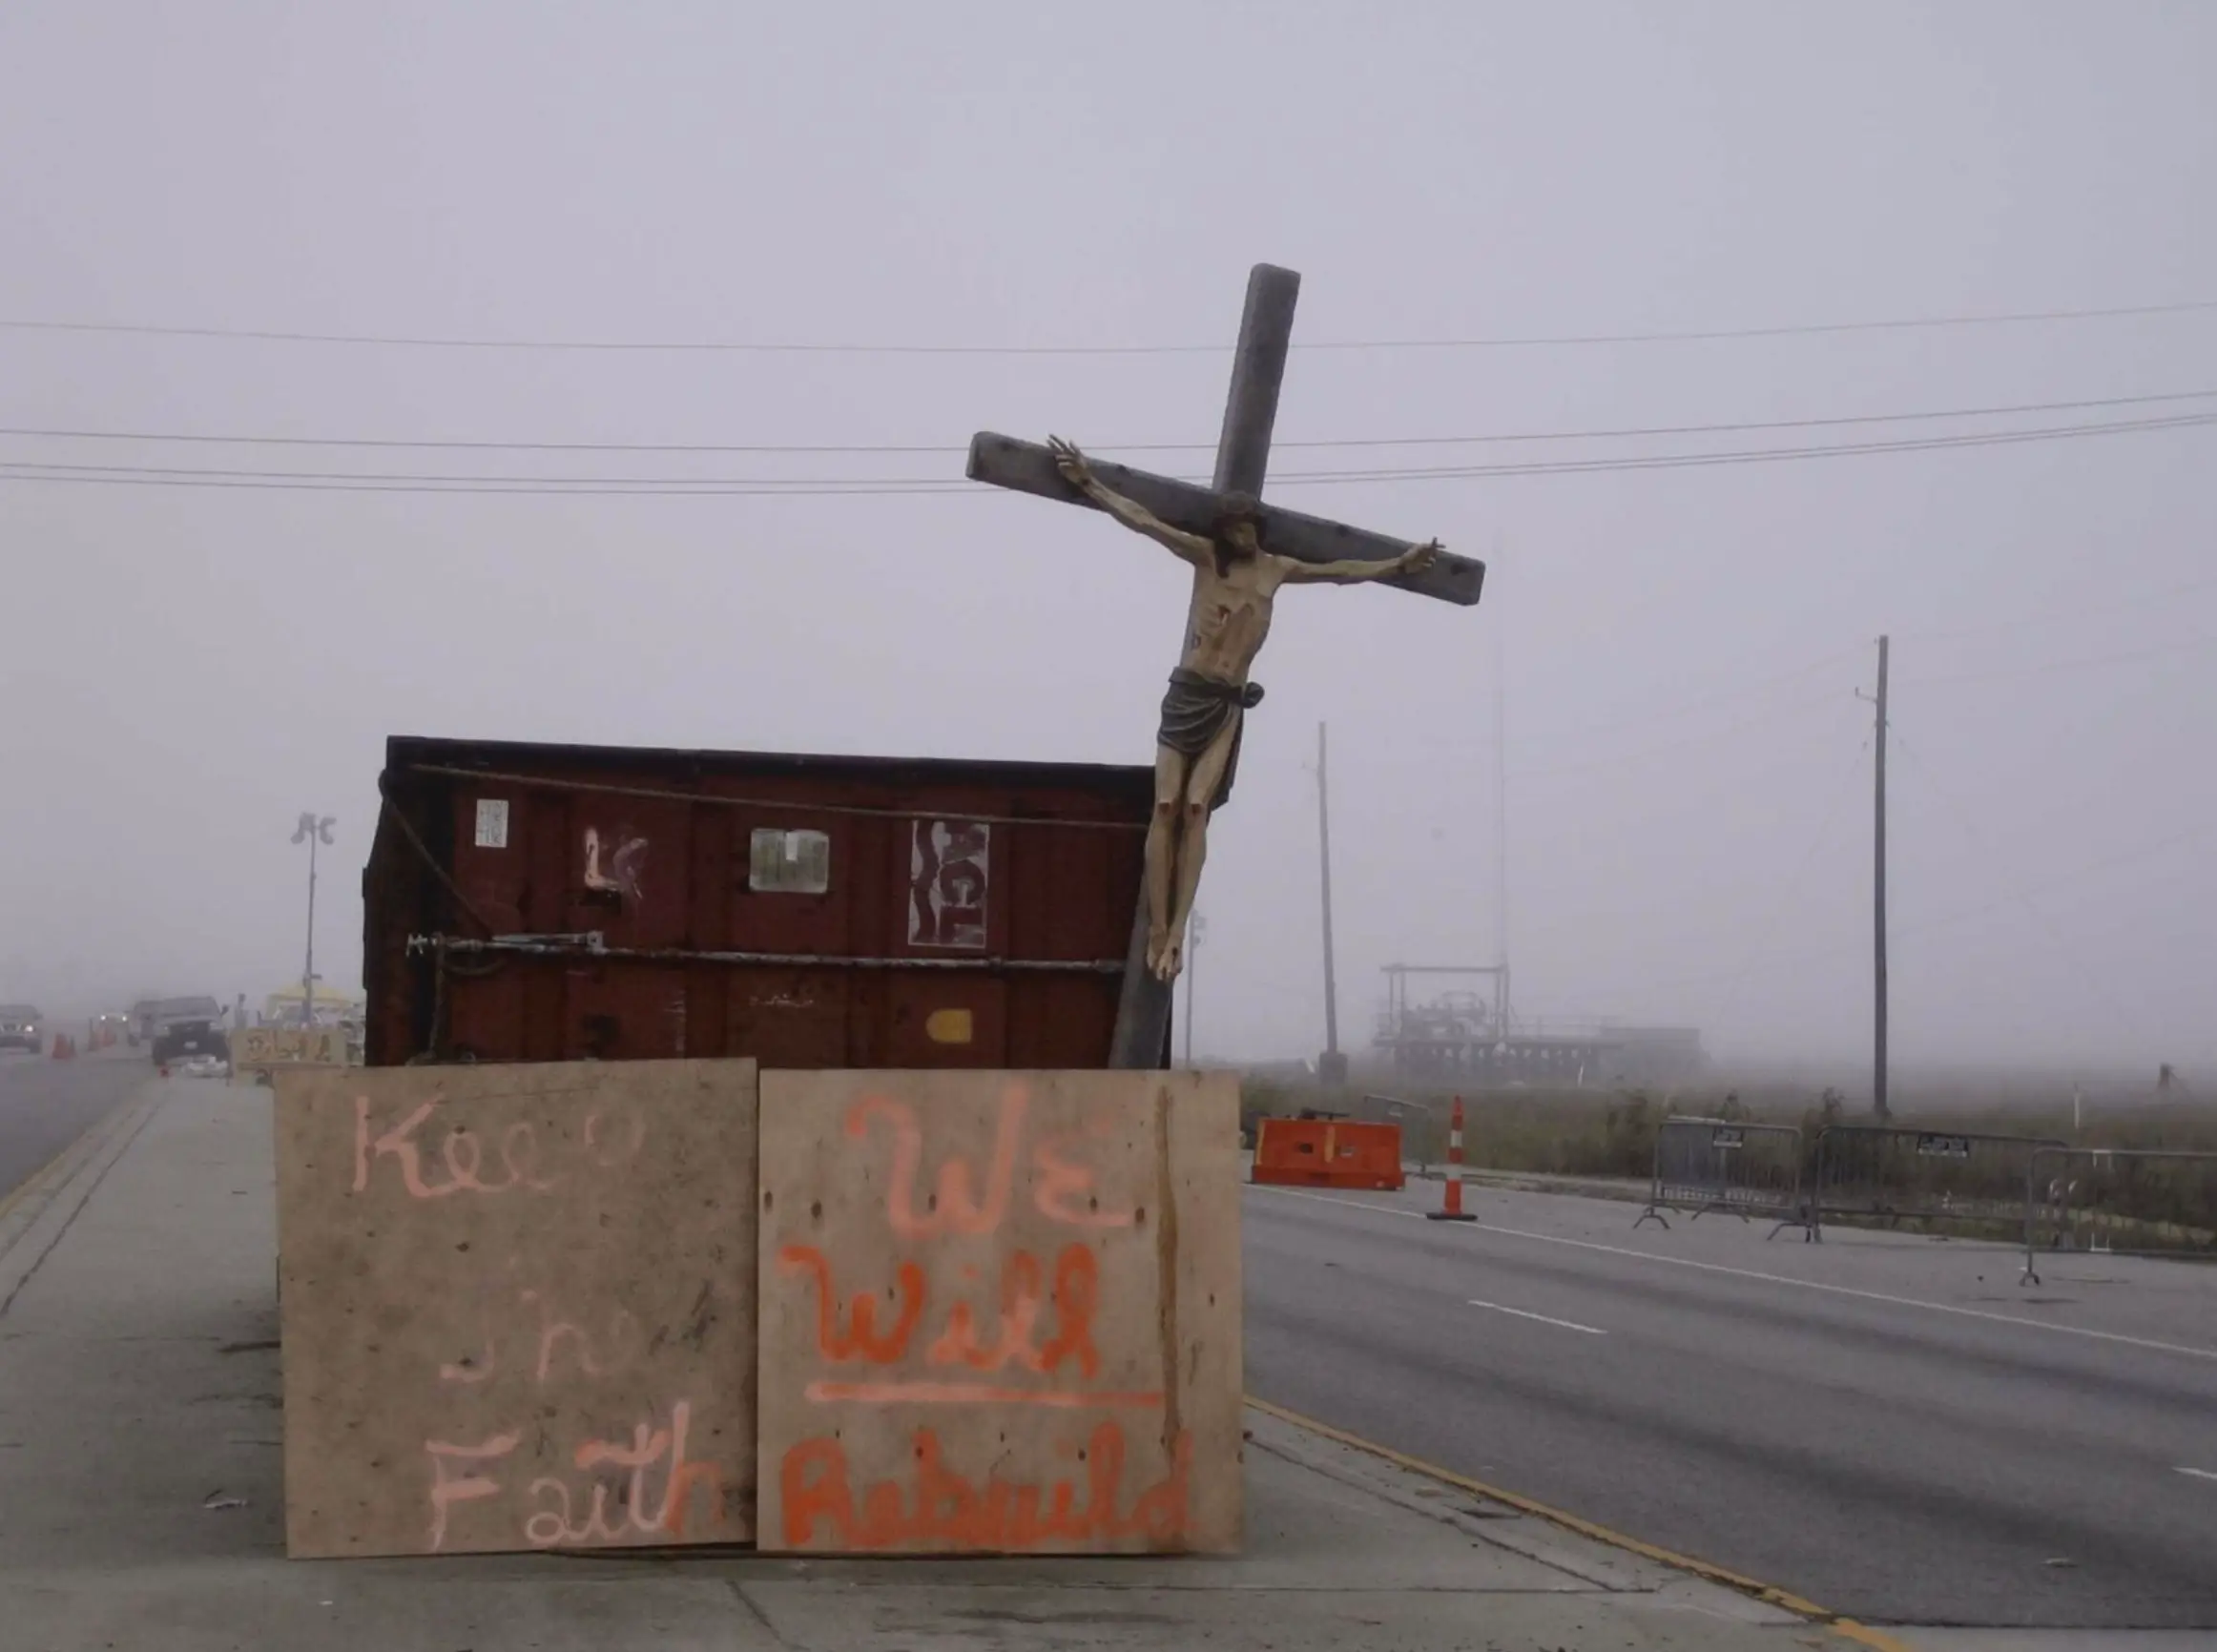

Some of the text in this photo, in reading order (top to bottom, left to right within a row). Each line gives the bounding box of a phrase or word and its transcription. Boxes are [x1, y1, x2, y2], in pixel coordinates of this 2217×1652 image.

[776, 1244, 1099, 1379] Will
[425, 1400, 727, 1553] Faith
[780, 1421, 1194, 1547] Rebuild
